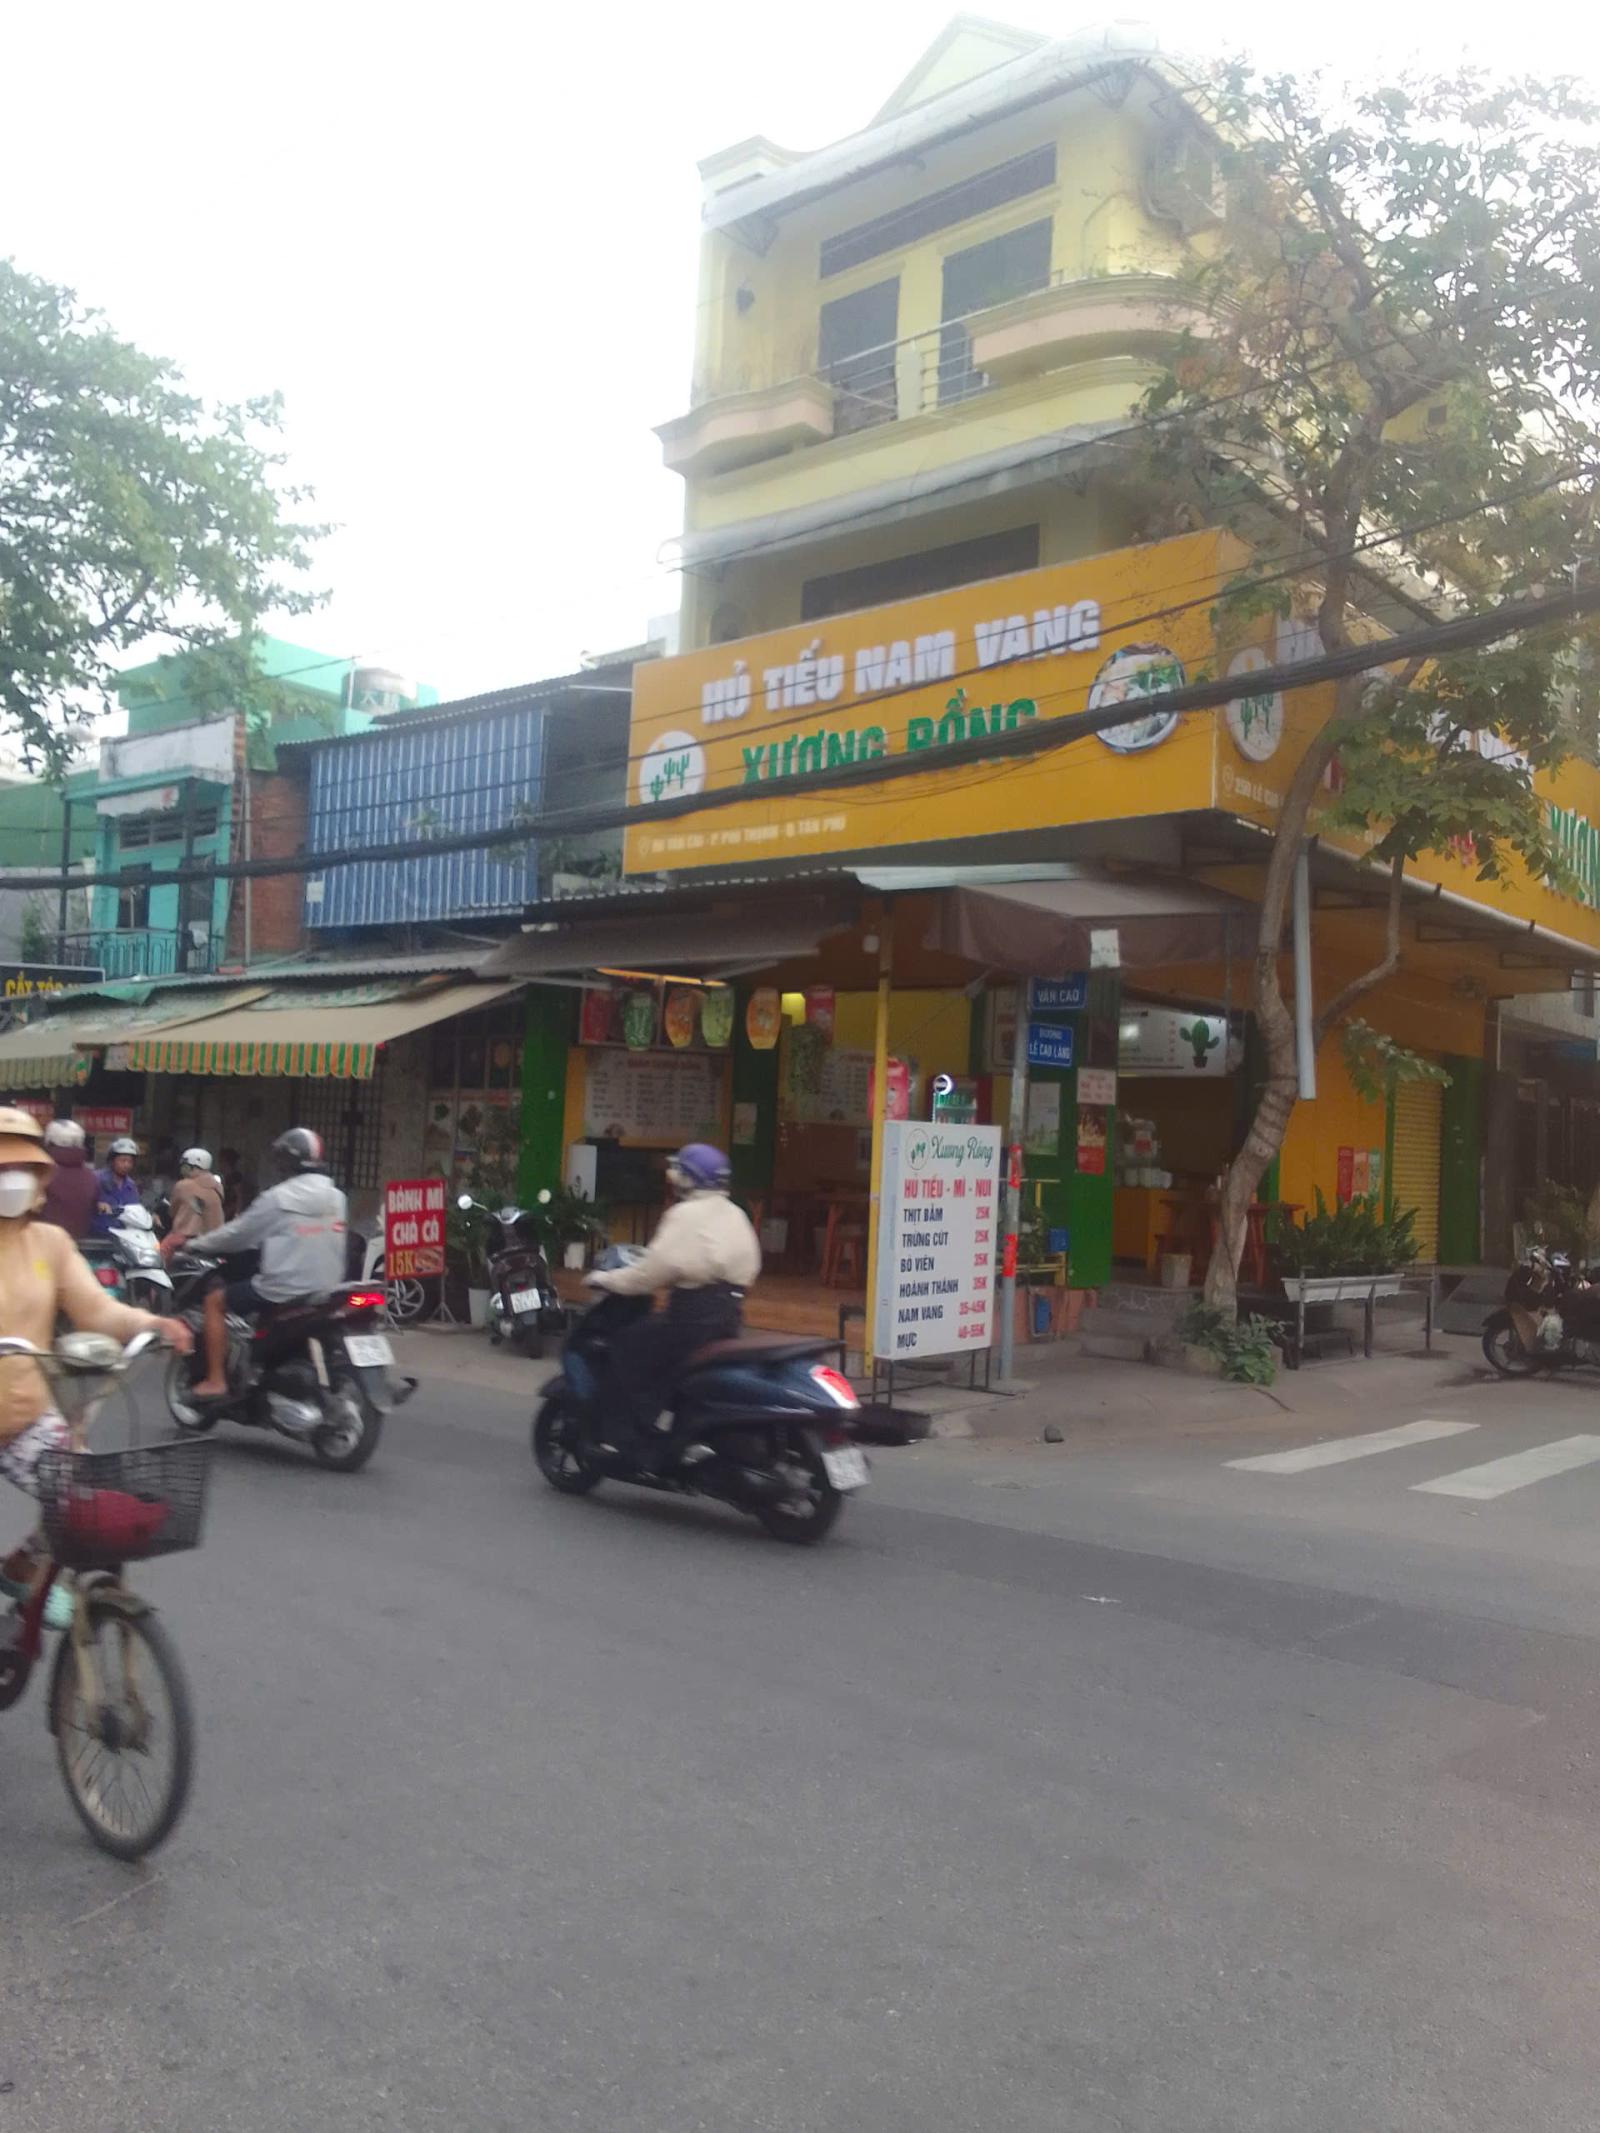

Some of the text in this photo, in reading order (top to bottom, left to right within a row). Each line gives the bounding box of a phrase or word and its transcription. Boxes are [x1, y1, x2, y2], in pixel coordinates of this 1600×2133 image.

[703, 600, 1100, 724] HỦ TIẾU NAM VANG
[975, 1179, 992, 1198] NUI
[388, 1184, 422, 1213] BÁNH
[903, 1208, 922, 1226] THỊT
[422, 1213, 439, 1243] CÁ
[388, 1250, 414, 1276] 15K
[915, 1254, 934, 1272] VIÊN
[898, 1307, 919, 1324] NAM
[922, 1305, 943, 1321] VANG
[897, 1332, 917, 1350] MỰC
